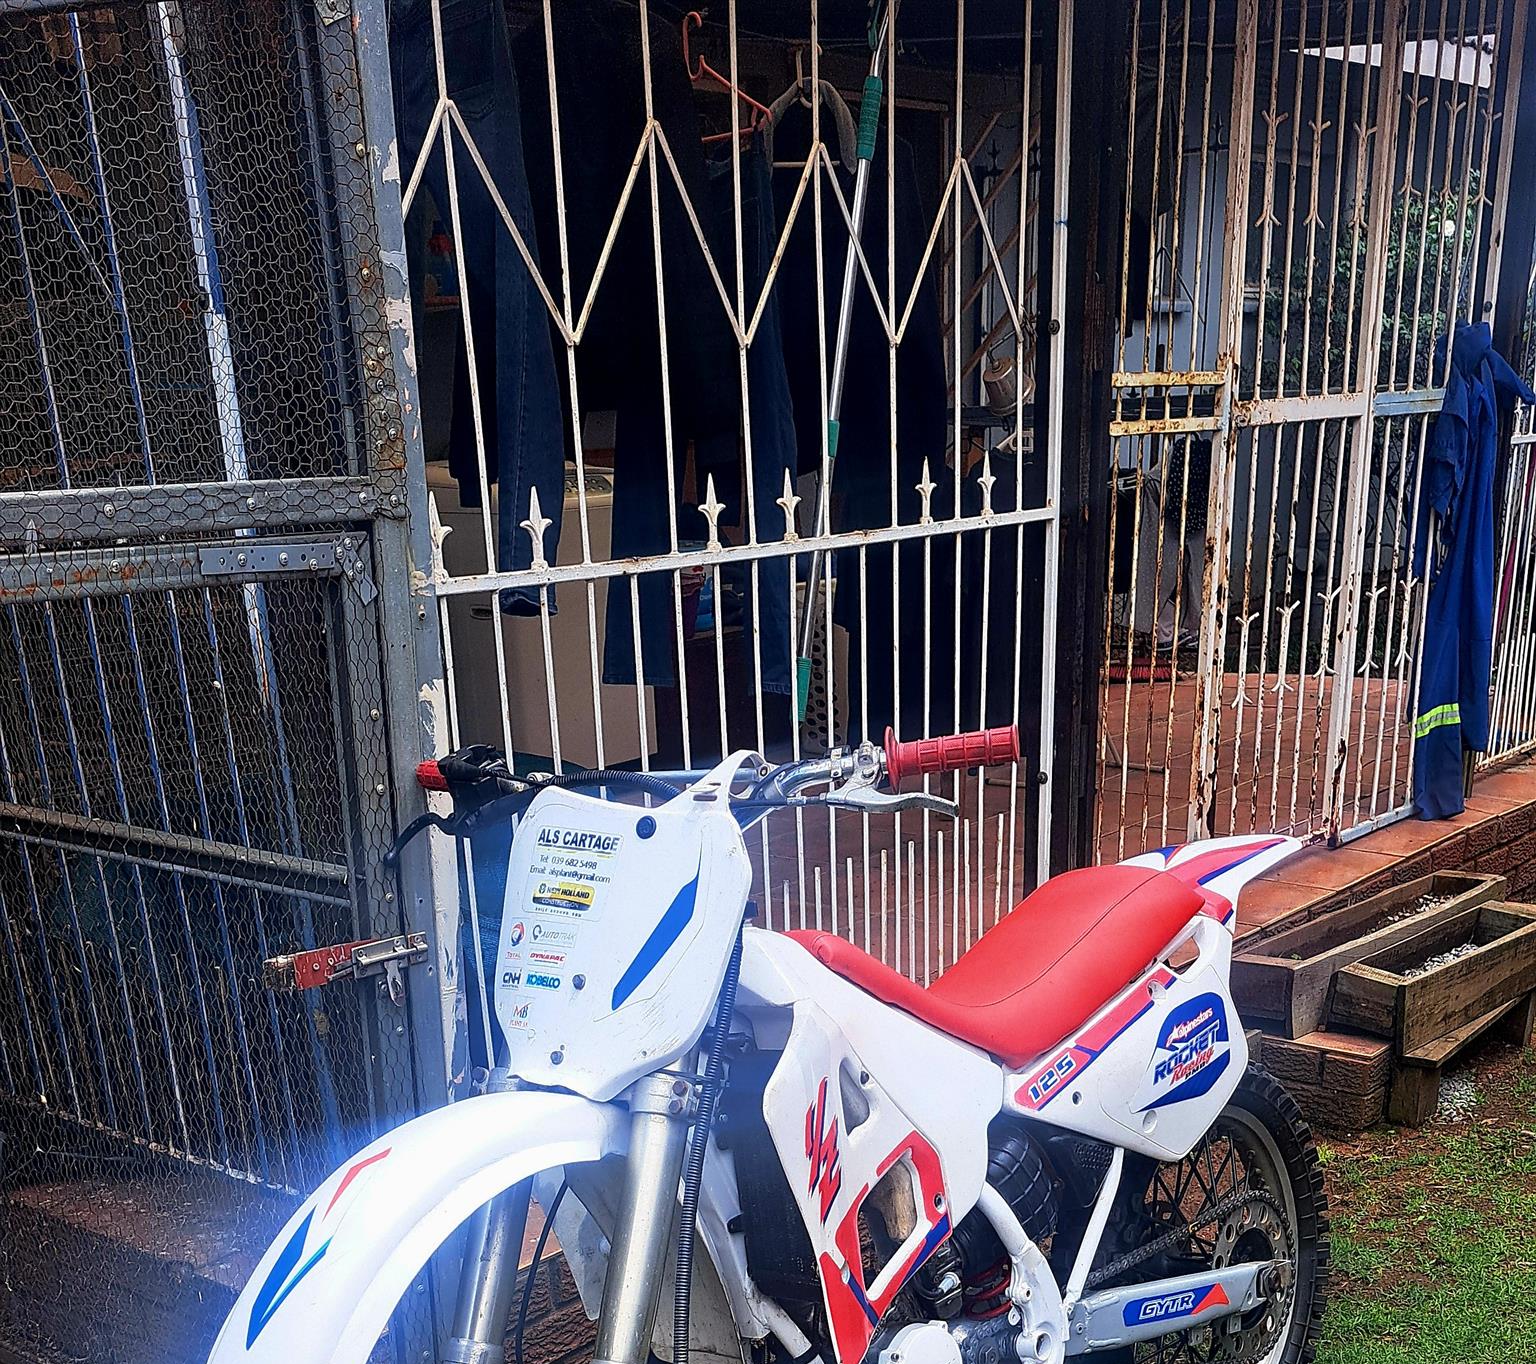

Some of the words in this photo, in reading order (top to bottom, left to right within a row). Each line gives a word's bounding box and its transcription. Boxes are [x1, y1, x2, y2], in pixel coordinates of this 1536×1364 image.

[538, 828, 560, 845] ALS
[562, 831, 620, 852] CARTAGE
[551, 856, 565, 865] 039
[565, 858, 579, 868] 682
[579, 859, 598, 870] 5498
[560, 887, 590, 899] HOLLAND
[530, 952, 566, 962] DYNAPAC
[503, 972, 521, 985] CNH
[526, 974, 560, 988] KOBELCO
[1153, 1018, 1220, 1086] ROCKET
[1168, 1045, 1216, 1087] Racing
[1027, 1051, 1077, 1103] 125
[1138, 1291, 1195, 1321] GYTR
